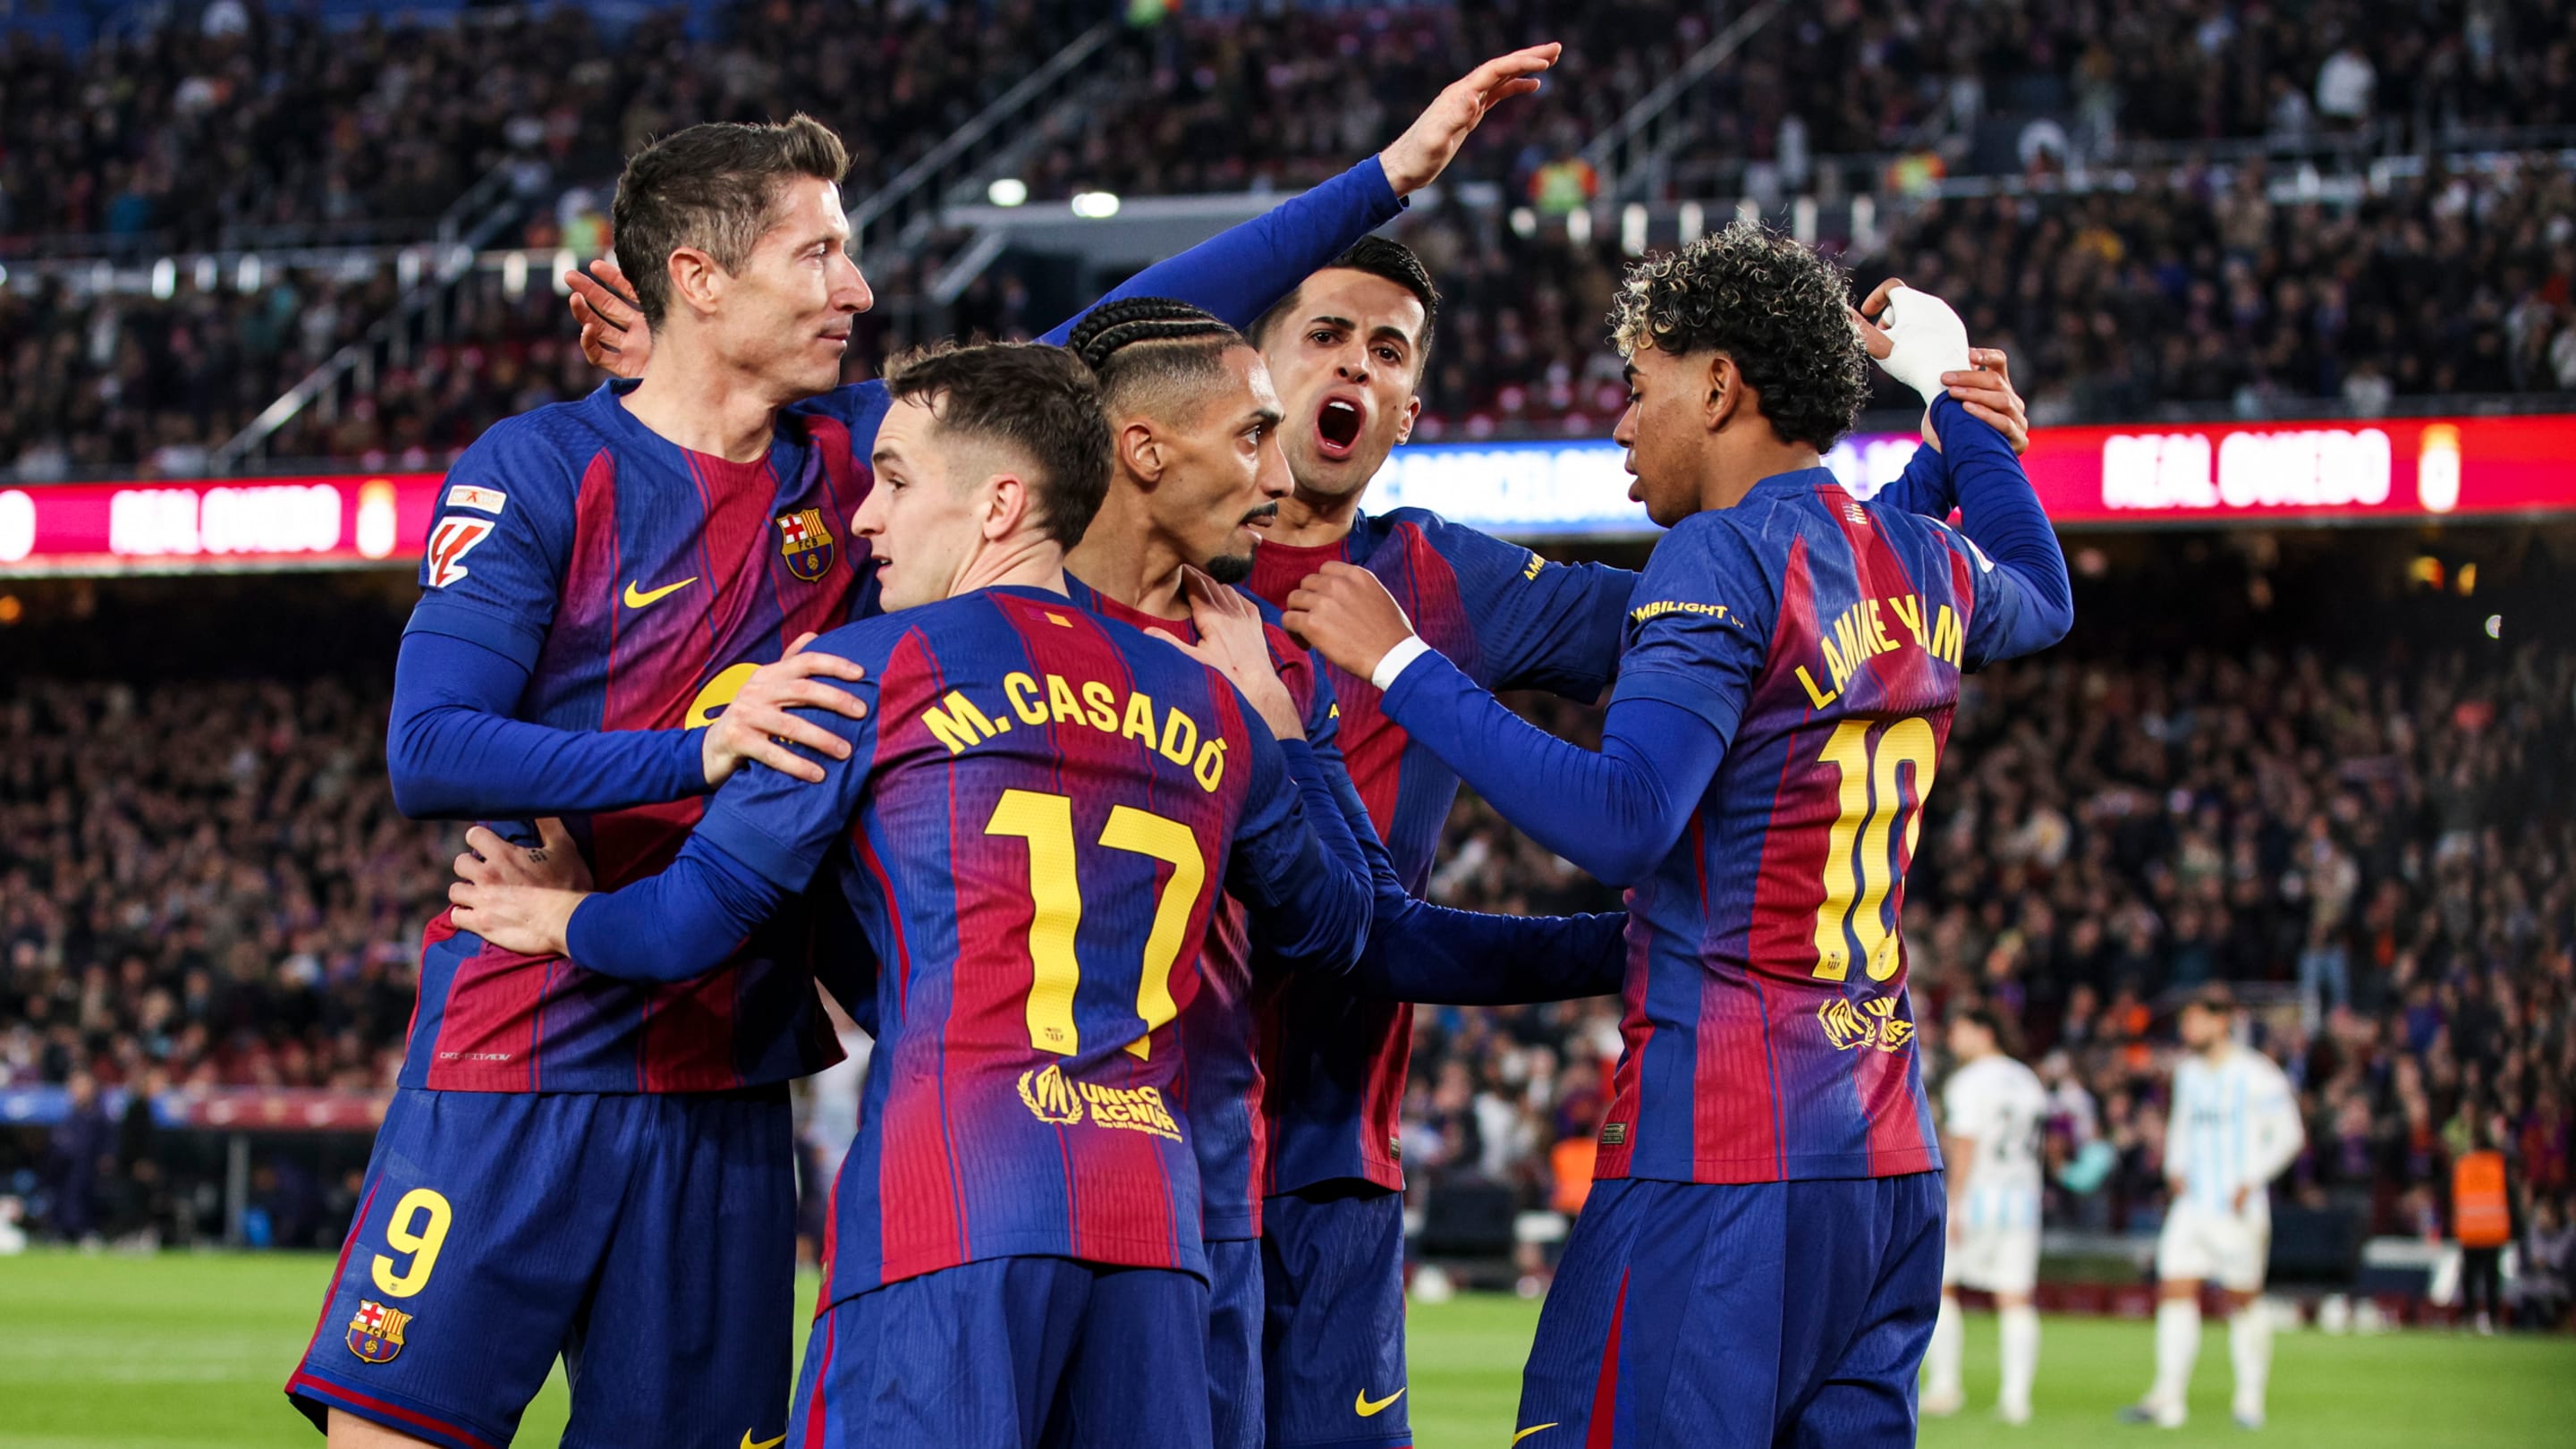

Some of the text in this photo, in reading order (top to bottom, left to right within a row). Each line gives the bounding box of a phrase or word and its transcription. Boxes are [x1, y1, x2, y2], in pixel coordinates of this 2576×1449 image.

[983, 788, 1206, 1063] 17
[1811, 716, 1936, 983] 10
[371, 1188, 453, 1298] 9
